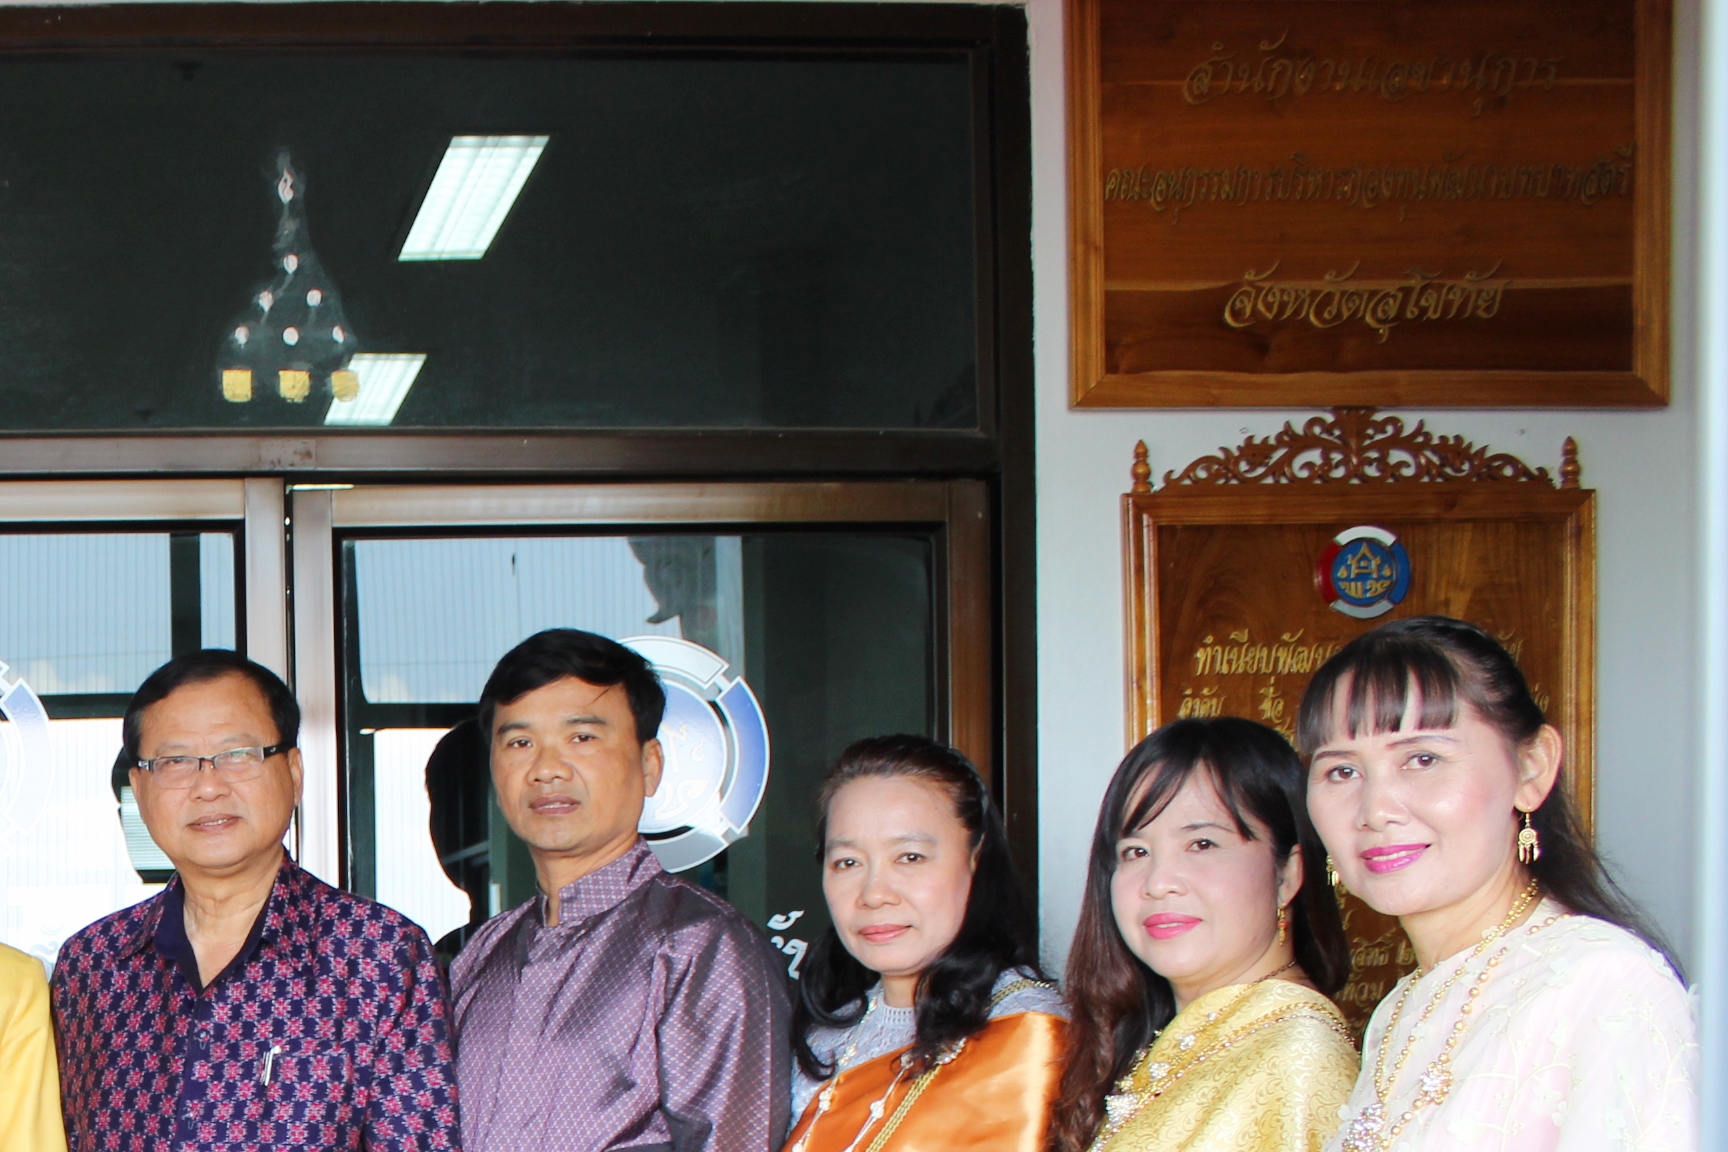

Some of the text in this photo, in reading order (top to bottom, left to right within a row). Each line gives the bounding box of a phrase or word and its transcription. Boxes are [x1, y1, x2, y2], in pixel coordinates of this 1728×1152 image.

[1222, 260, 1512, 344] จังหวัดสุโขทัย
